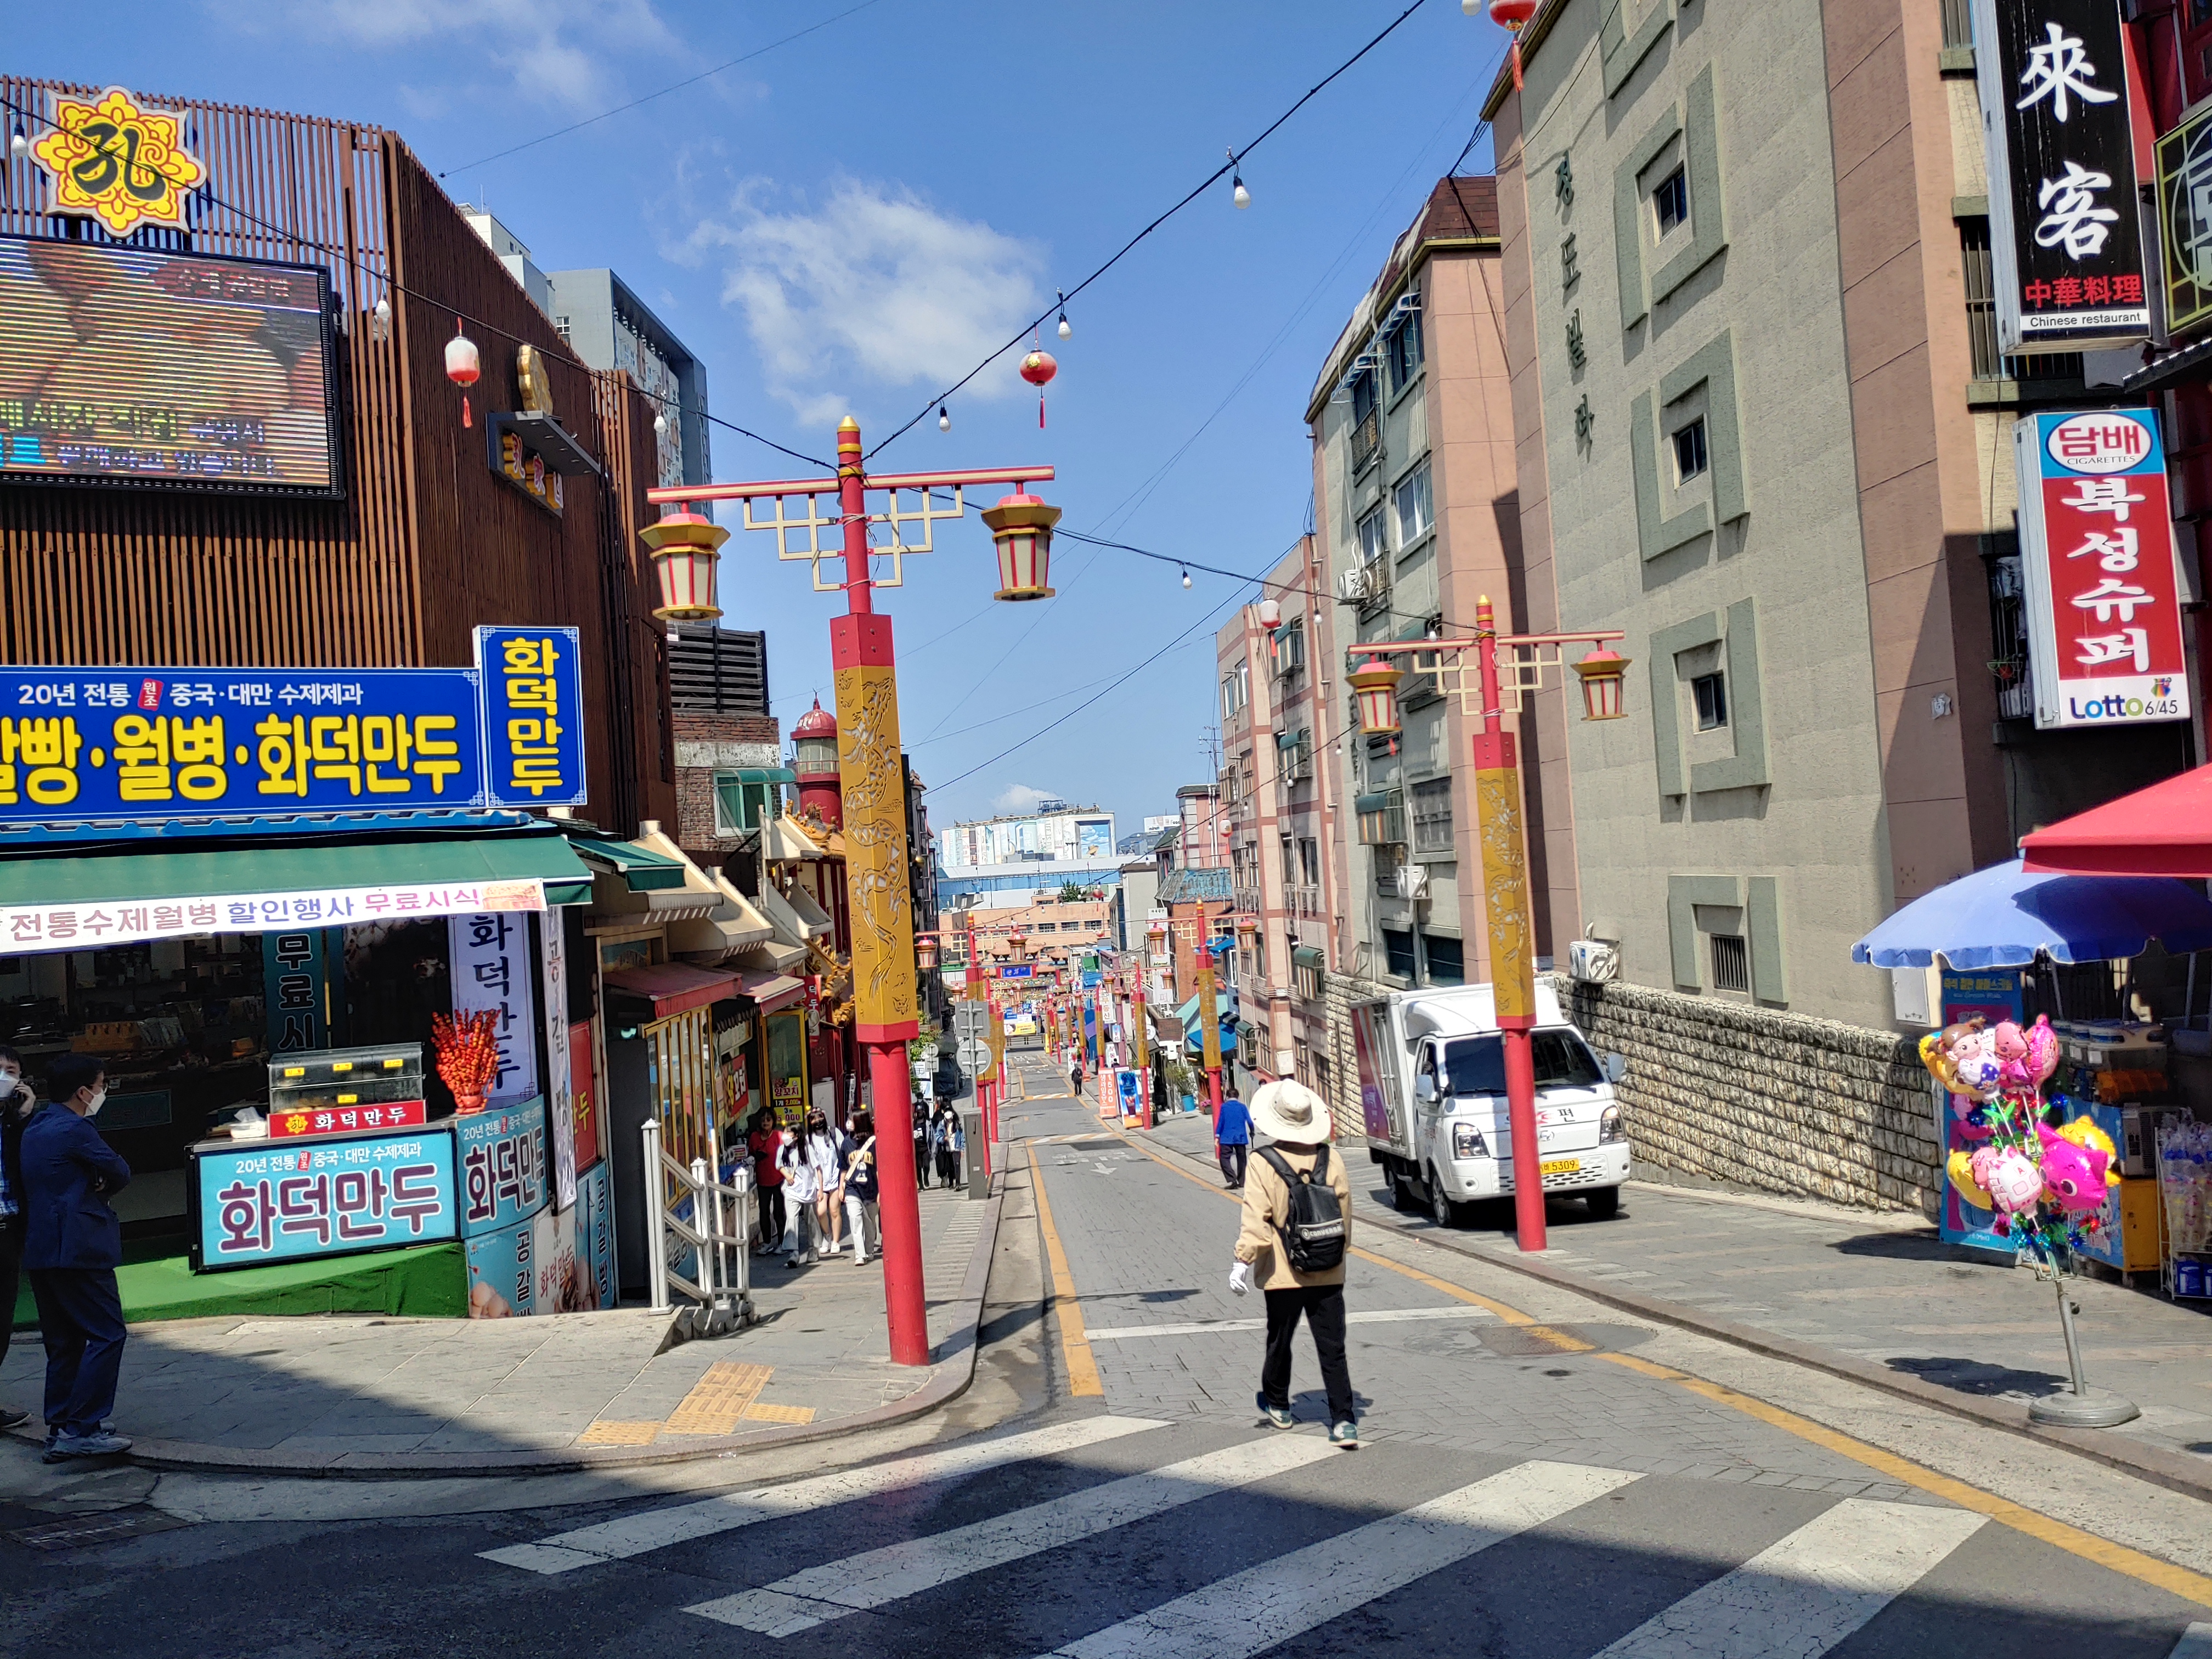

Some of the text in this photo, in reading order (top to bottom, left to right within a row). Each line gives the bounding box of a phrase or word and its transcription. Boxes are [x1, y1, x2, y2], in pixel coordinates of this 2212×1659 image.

[2016, 21, 2119, 261] 來客
[2025, 274, 2143, 308] 中華料理
[2030, 313, 2141, 327] Chinese restaurant
[2058, 424, 2140, 458] 담배
[2067, 455, 2136, 466] CIGARETTES
[18, 683, 76, 707] 20년
[83, 683, 131, 707] 전통
[143, 682, 158, 707] 원조
[278, 682, 364, 706] 수제제과
[2070, 695, 2179, 719] Lotto 6/45
[502, 637, 563, 797] 화덕만두
[10, 885, 481, 942] 전통수제월병 할인행사 무료시식
[775, 1087, 799, 1097] 양꼬치
[315, 1107, 407, 1131] 화덕만두
[464, 1123, 484, 1141] 20년
[485, 1119, 500, 1137] 전통
[236, 1159, 267, 1174] 20년
[270, 1155, 296, 1172] 전통
[372, 1142, 422, 1161] 수제제과
[1552, 1160, 1575, 1171] 5309
[464, 1125, 545, 1223] 화덕만두
[218, 1163, 442, 1253] 화덕만두
